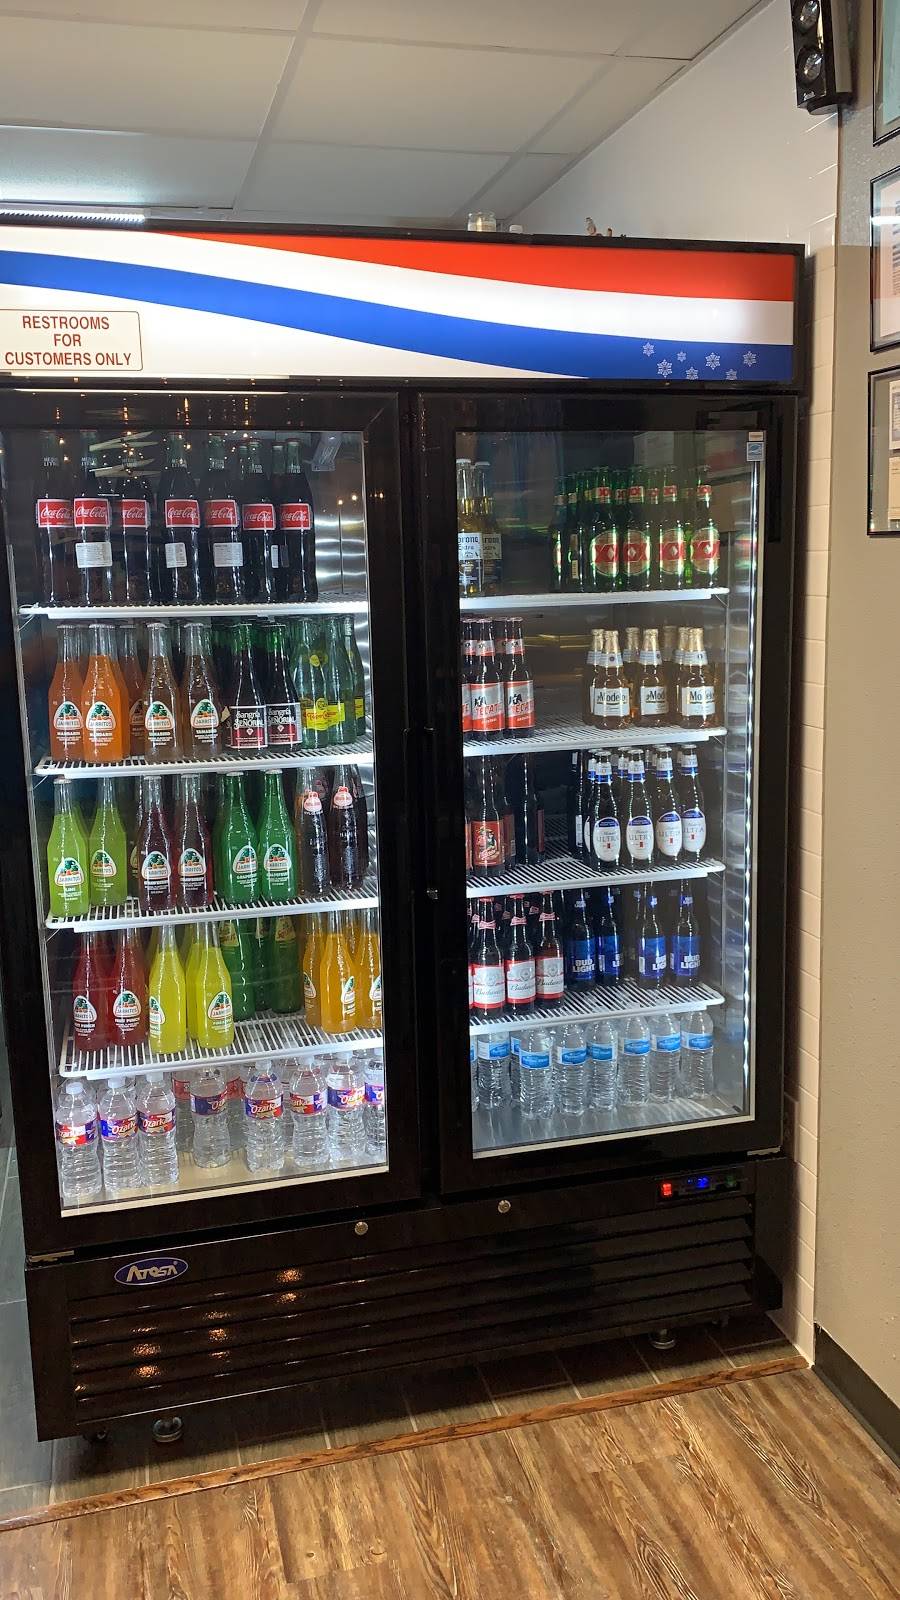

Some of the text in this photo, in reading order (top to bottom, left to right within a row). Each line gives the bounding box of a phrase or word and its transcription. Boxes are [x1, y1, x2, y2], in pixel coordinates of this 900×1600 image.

[22, 315, 110, 330] RESTROOMS
[53, 333, 82, 347] FOR
[5, 351, 131, 366] CUSTOMERS ONLY
[76, 506, 108, 519] Coca-Cola
[167, 506, 199, 520] Coca-Cola
[572, 963, 596, 973] LIGHT
[575, 958, 594, 967] BUD
[112, 1121, 137, 1135] Ozark
